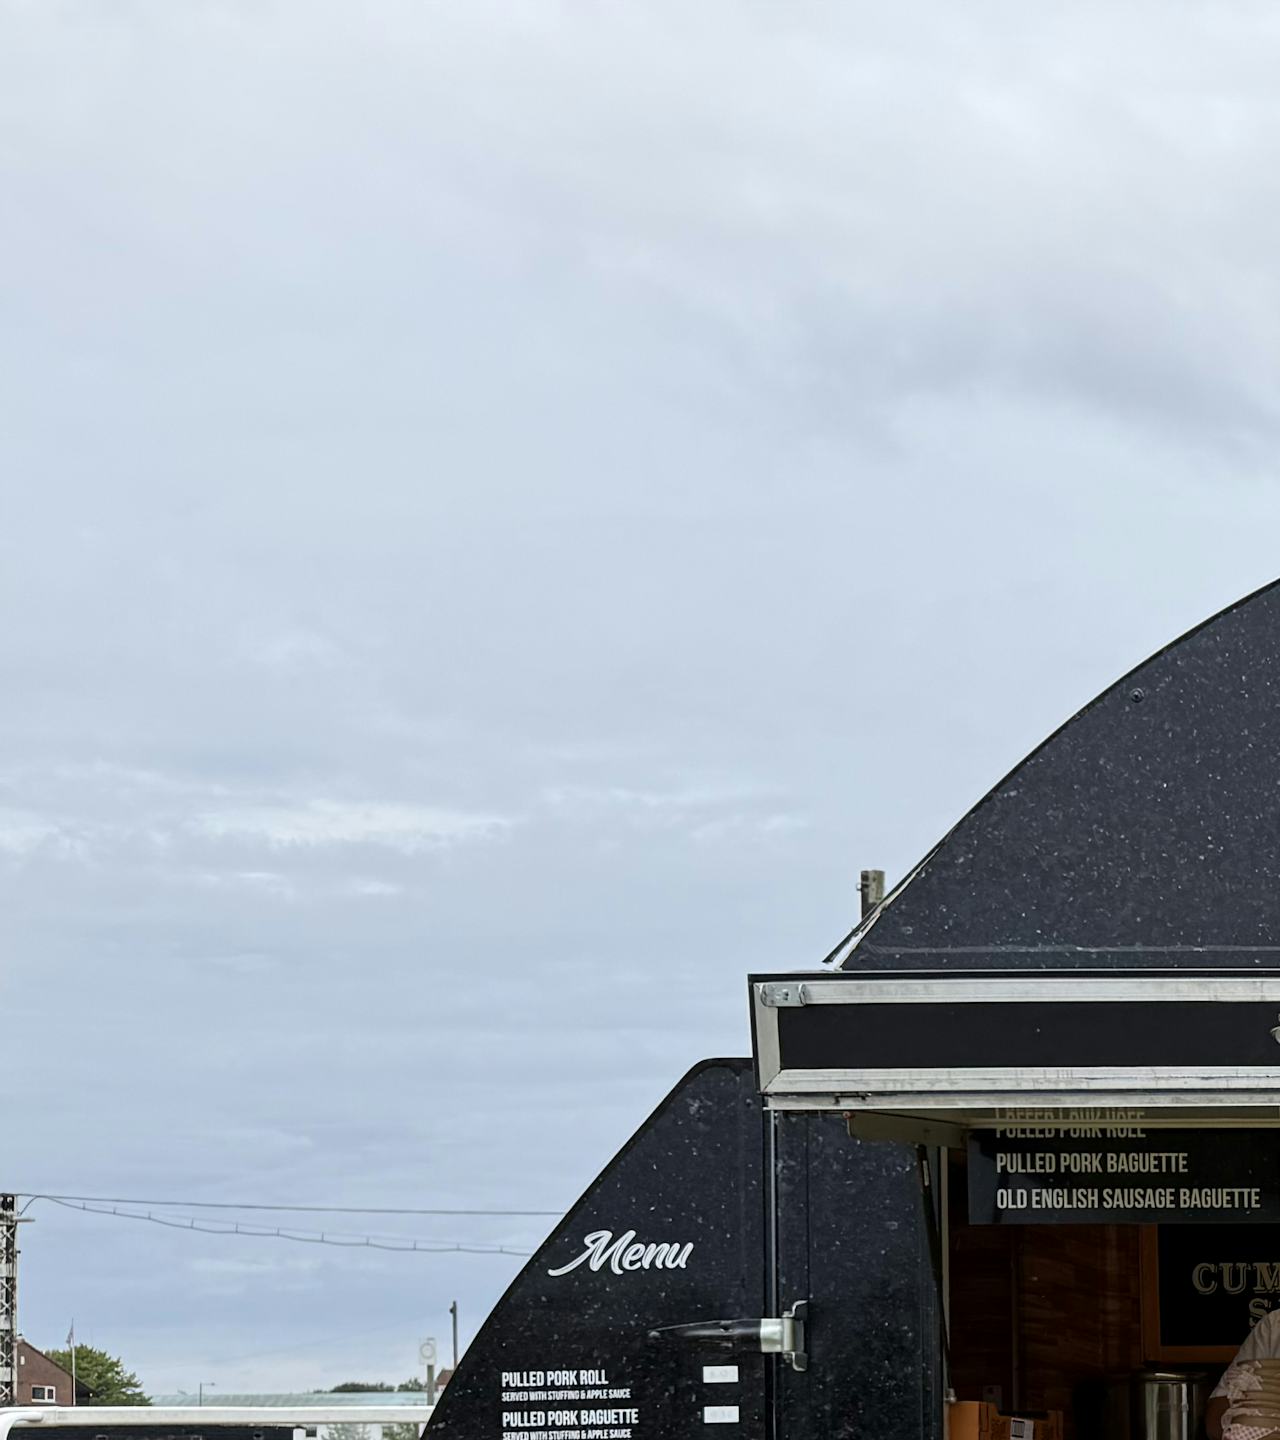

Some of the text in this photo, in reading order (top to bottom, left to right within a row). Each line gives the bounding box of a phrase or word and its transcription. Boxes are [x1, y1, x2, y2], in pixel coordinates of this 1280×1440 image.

[997, 1153, 1188, 1174] PULLED PORK BAGUETTE
[997, 1188, 1260, 1209] OLD ENGLISH SAUSAGE BAGUETTE
[548, 1230, 694, 1277] Menu
[502, 1370, 608, 1387] PULLED PORK ROLL
[503, 1409, 639, 1427] PULLED PORK BAGUETTE
